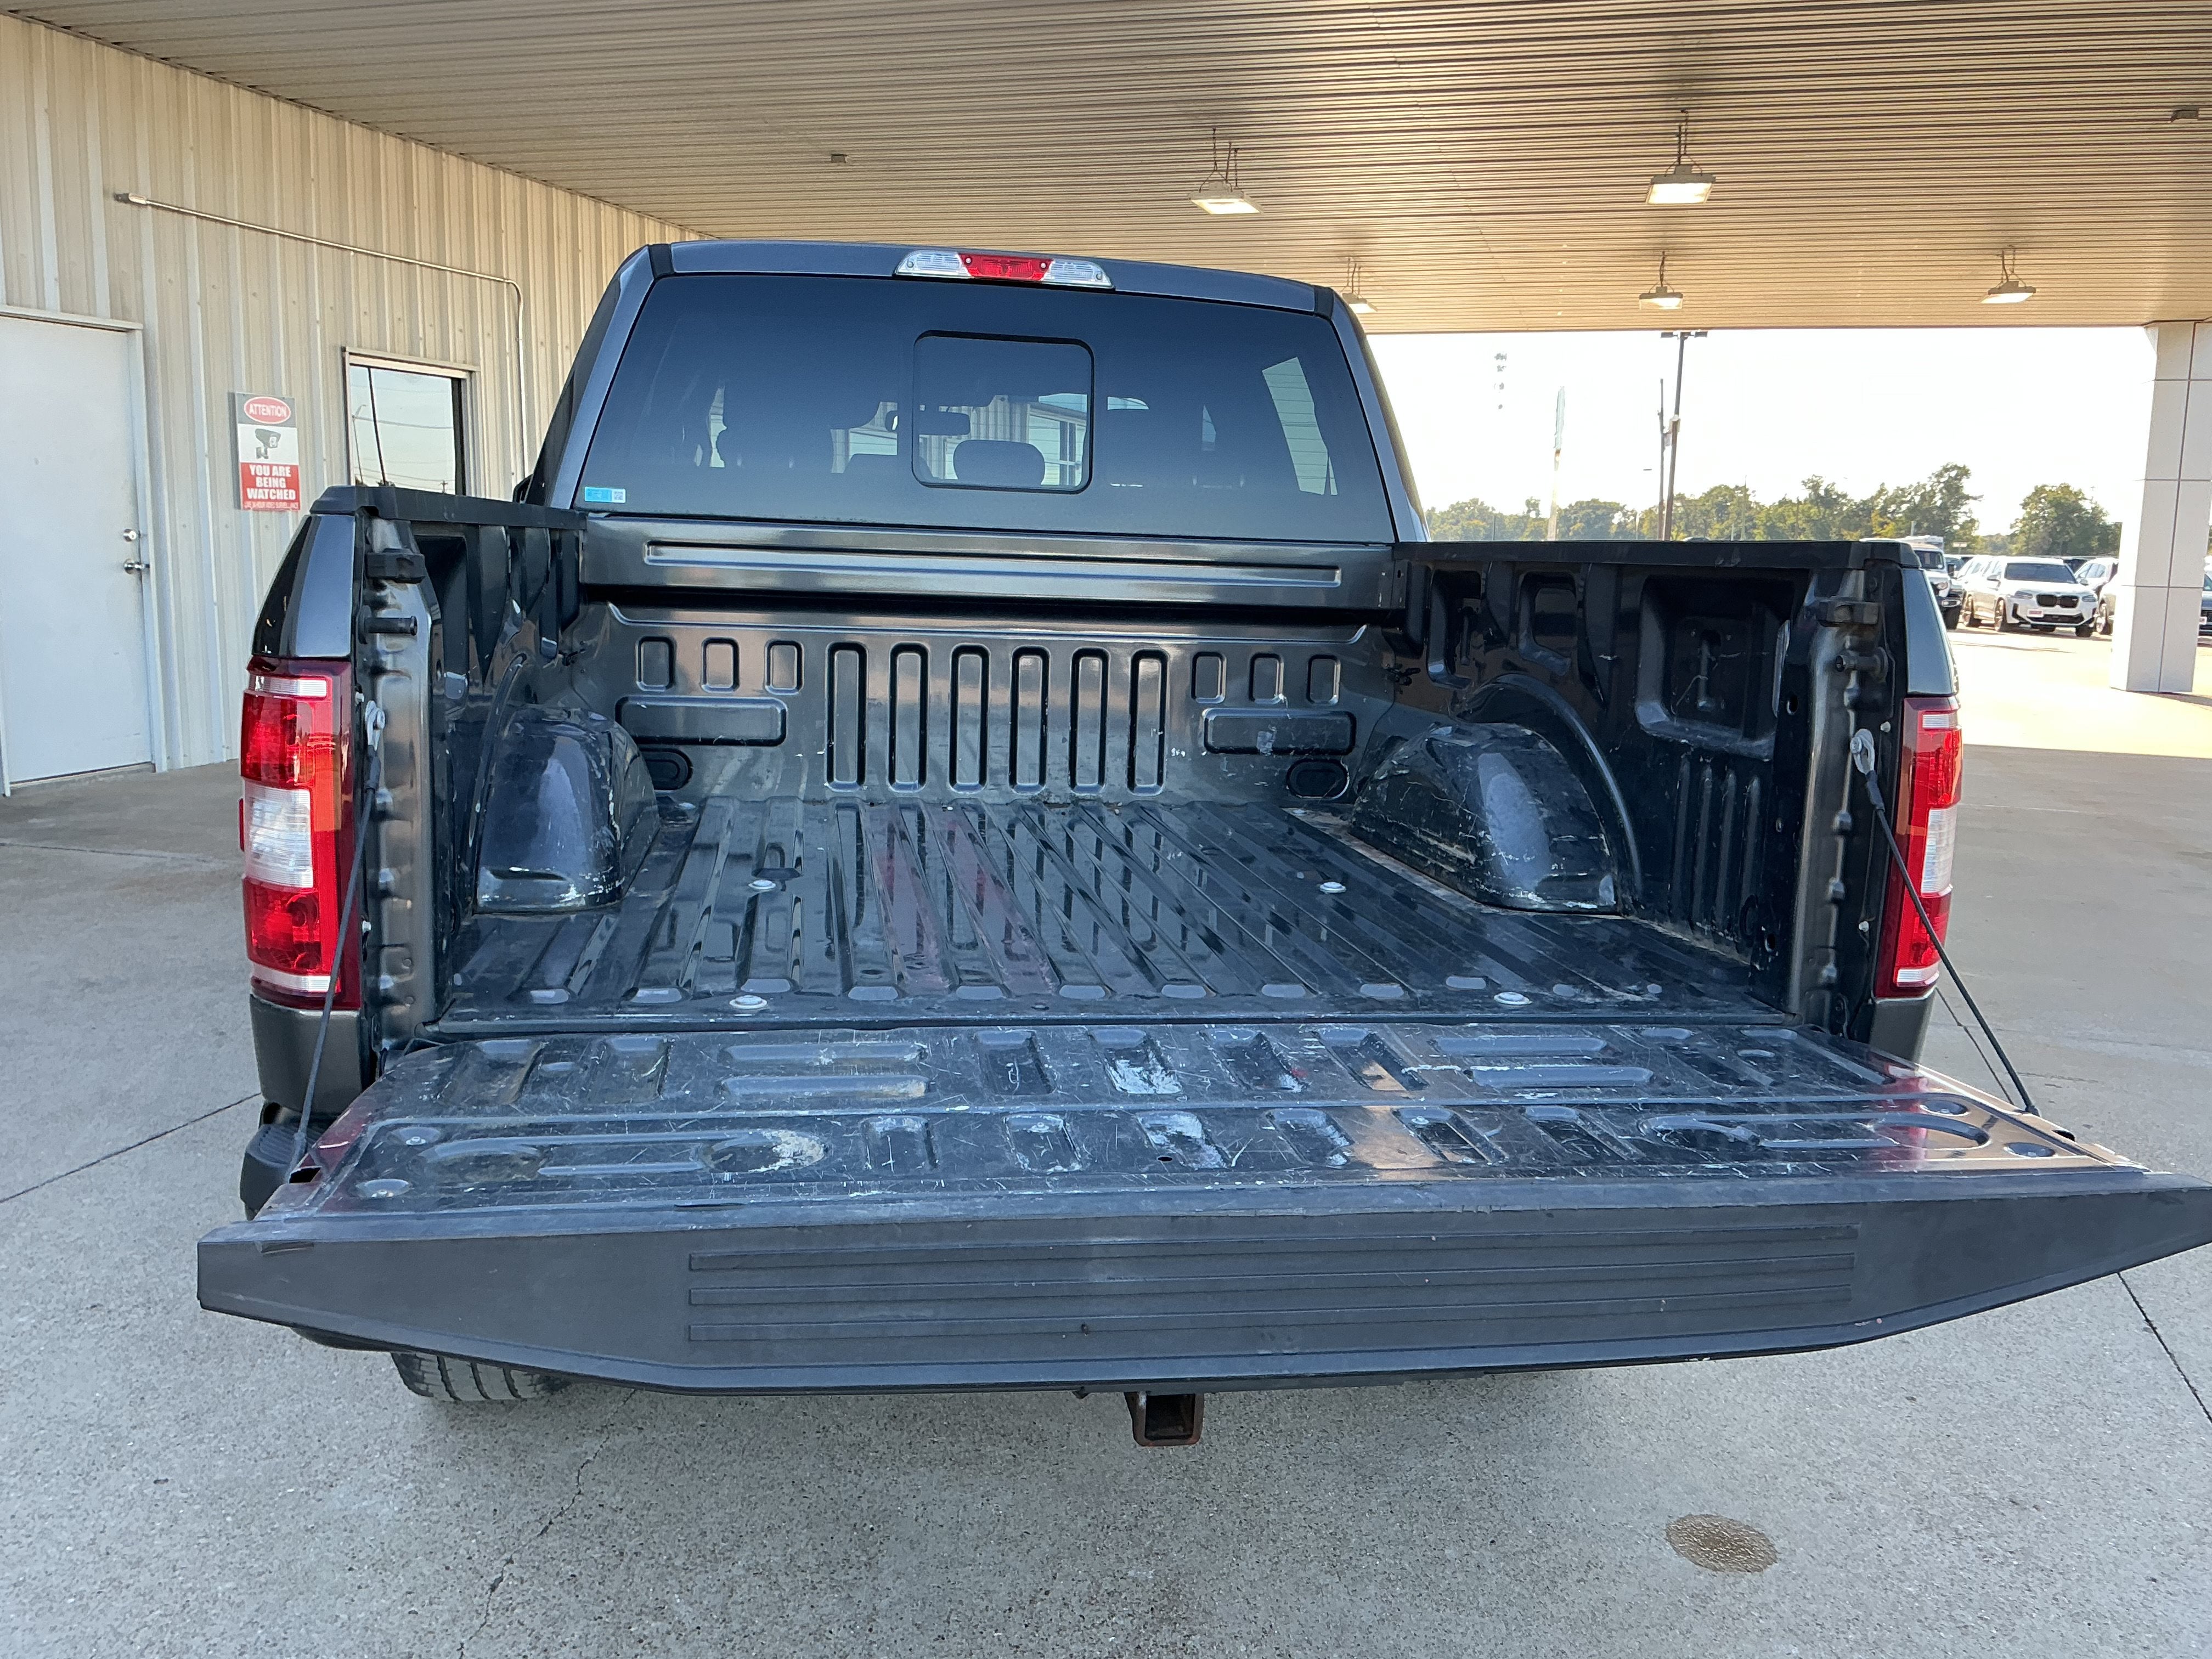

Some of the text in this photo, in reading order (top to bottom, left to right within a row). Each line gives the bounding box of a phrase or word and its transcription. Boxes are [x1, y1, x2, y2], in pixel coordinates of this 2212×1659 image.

[249, 403, 286, 417] ATTENTION
[249, 465, 291, 477] YOU ARE
[255, 476, 286, 488] BEING
[246, 488, 296, 500] WATCHED
